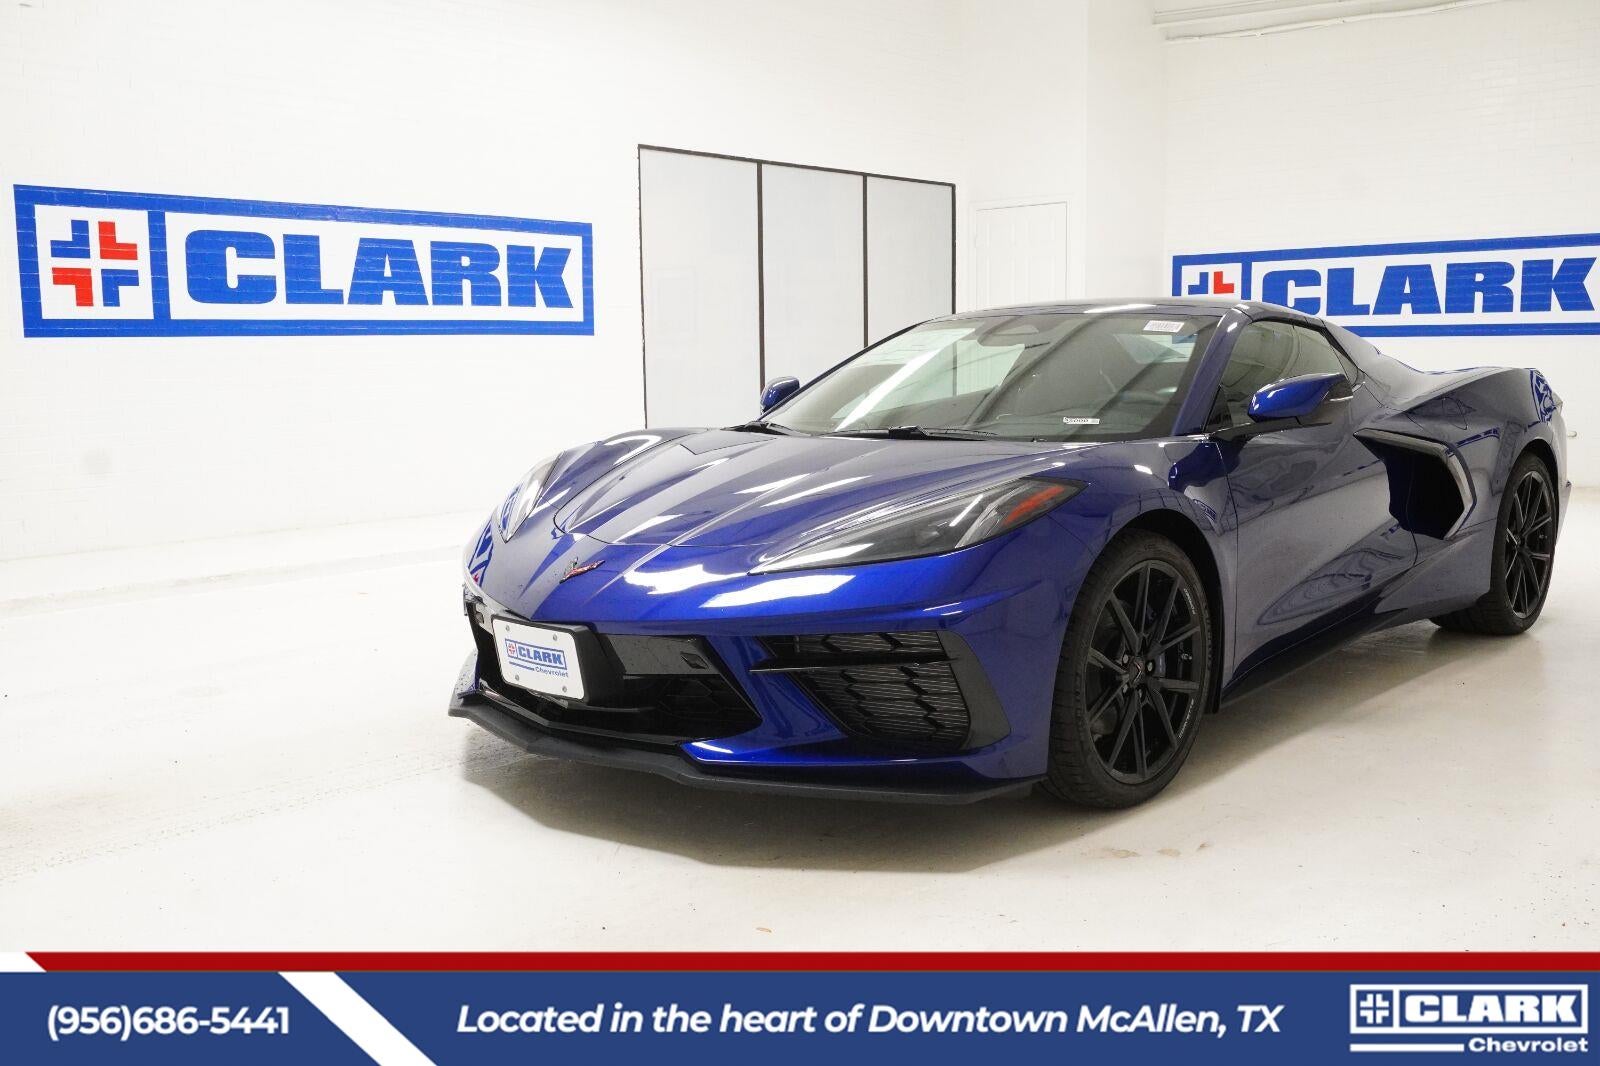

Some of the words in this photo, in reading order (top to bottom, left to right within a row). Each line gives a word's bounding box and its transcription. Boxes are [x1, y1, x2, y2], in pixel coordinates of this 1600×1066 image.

[185, 230, 574, 309] CLARK
[1262, 257, 1597, 316] CLARK
[518, 646, 564, 665] CLARK
[535, 666, 569, 677] Chevrolet
